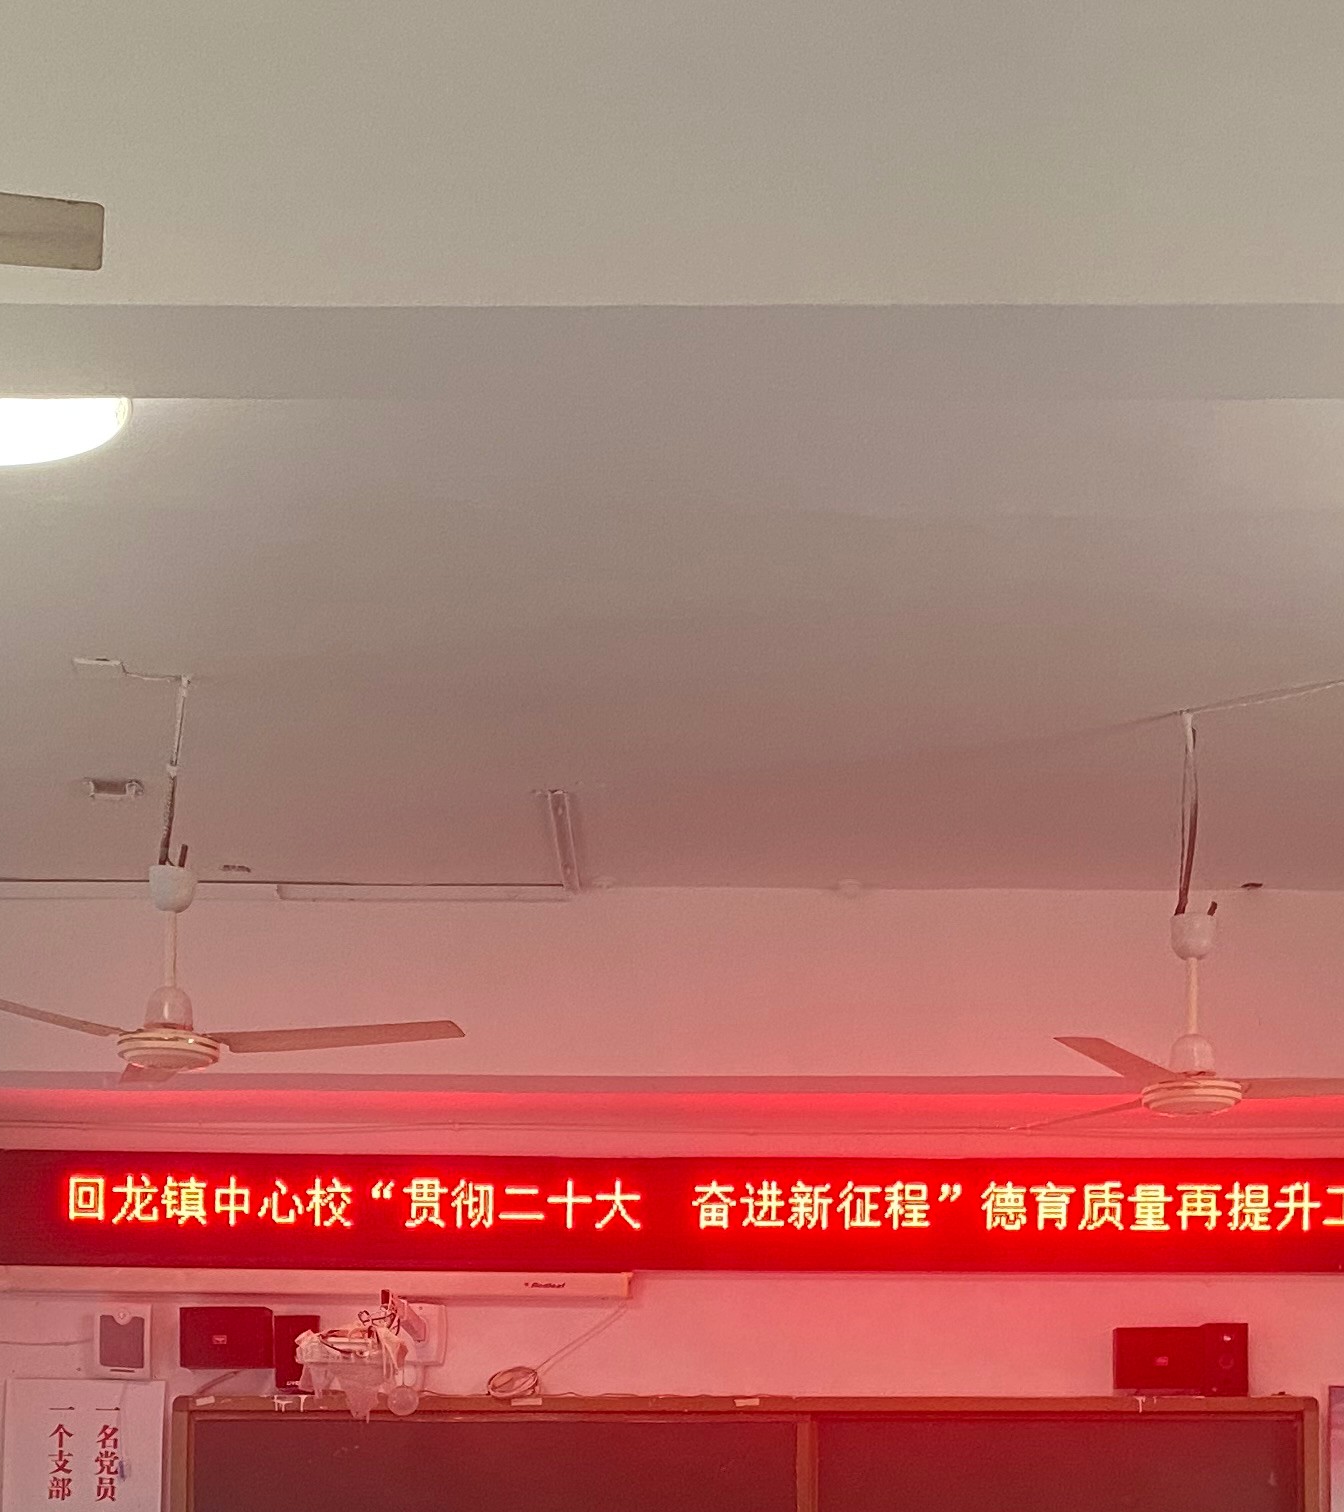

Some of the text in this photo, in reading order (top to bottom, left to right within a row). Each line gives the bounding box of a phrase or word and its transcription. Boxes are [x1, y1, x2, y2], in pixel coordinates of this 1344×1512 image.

[67, 1175, 641, 1229] 回龙镇中心校“贯彻二十大
